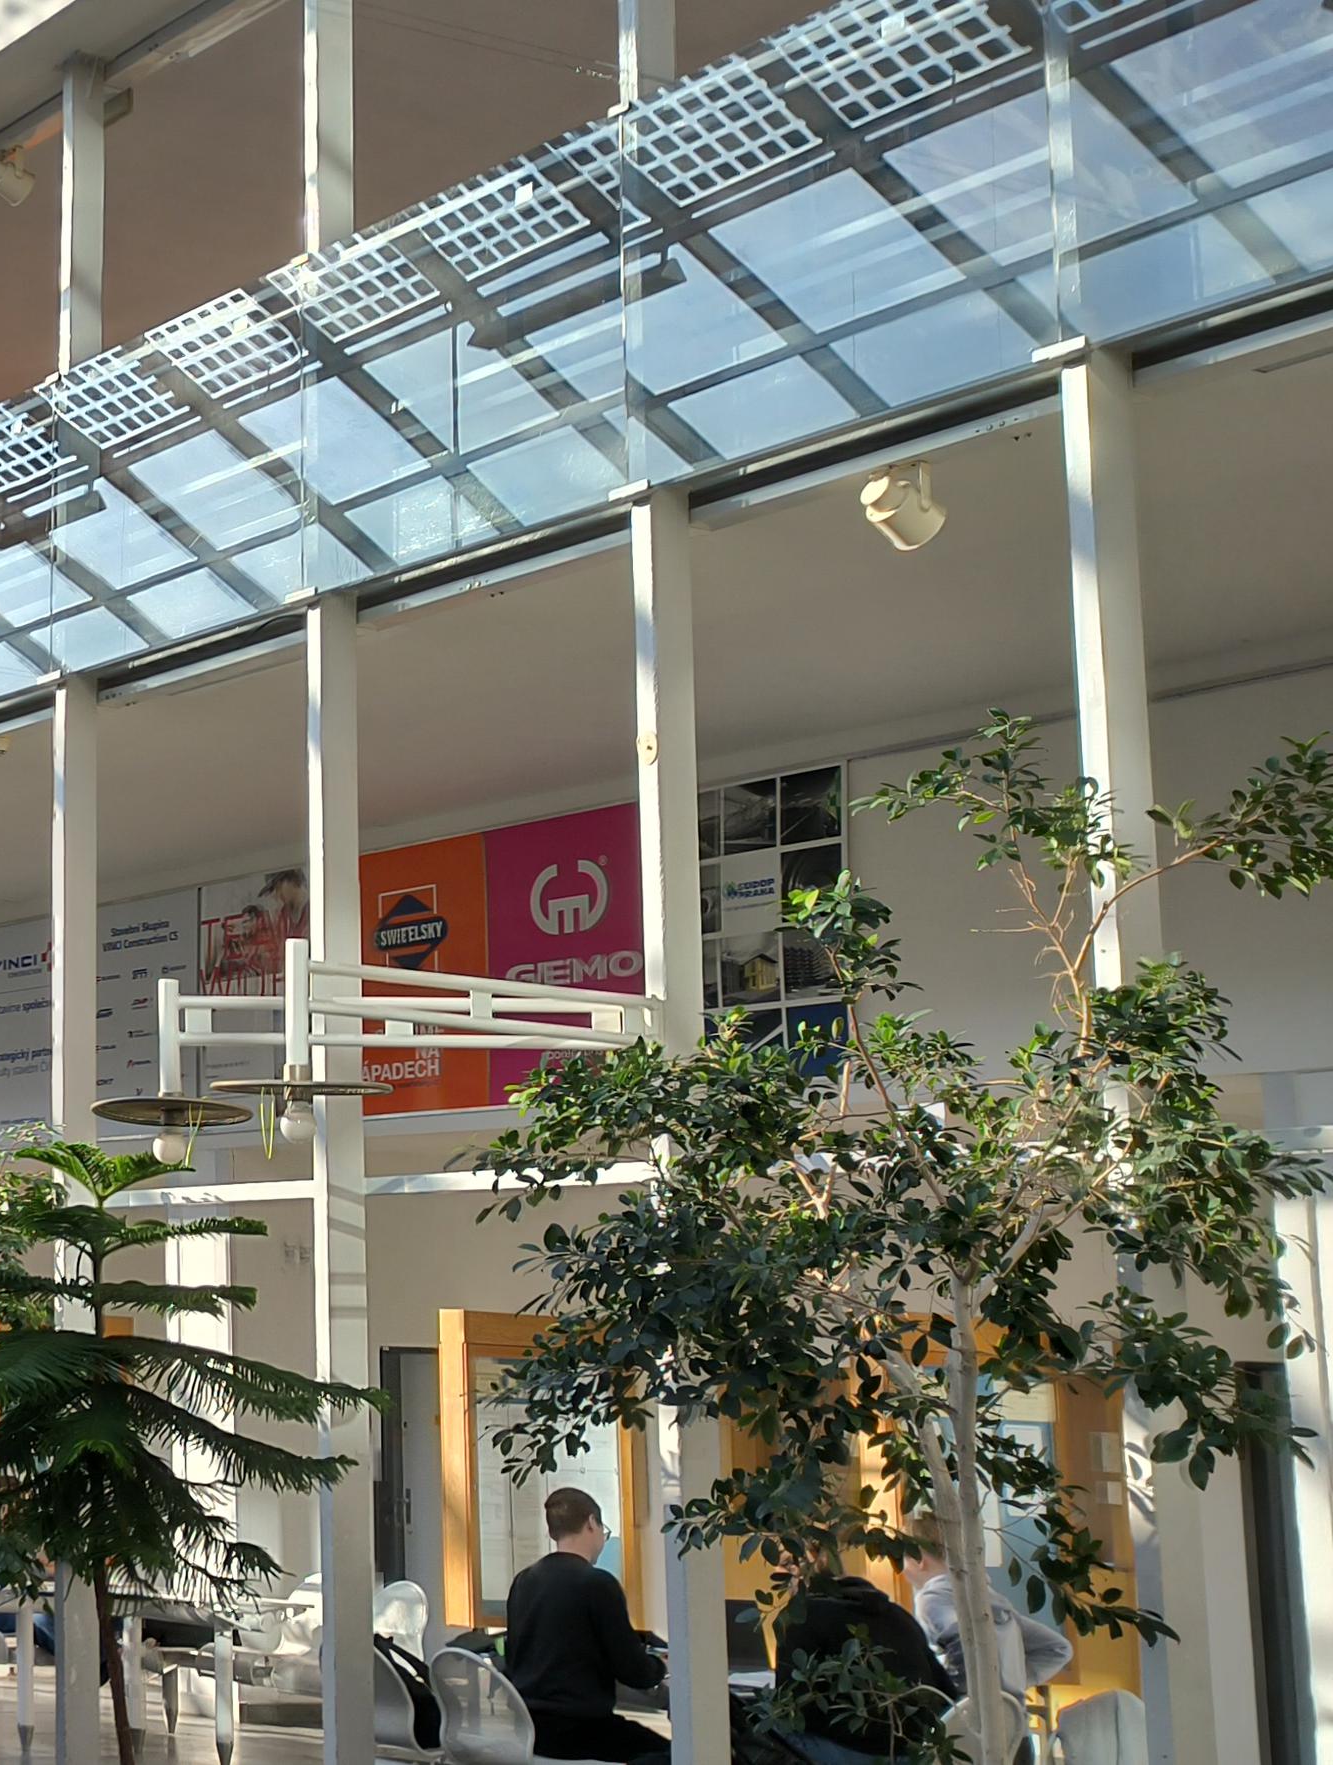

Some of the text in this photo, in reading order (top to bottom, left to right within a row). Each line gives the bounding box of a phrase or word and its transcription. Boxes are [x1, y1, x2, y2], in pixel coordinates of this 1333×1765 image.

[380, 920, 443, 947] SWIETELSKY
[505, 950, 644, 985] GEMO
[362, 1060, 441, 1082] ÁPADECH
